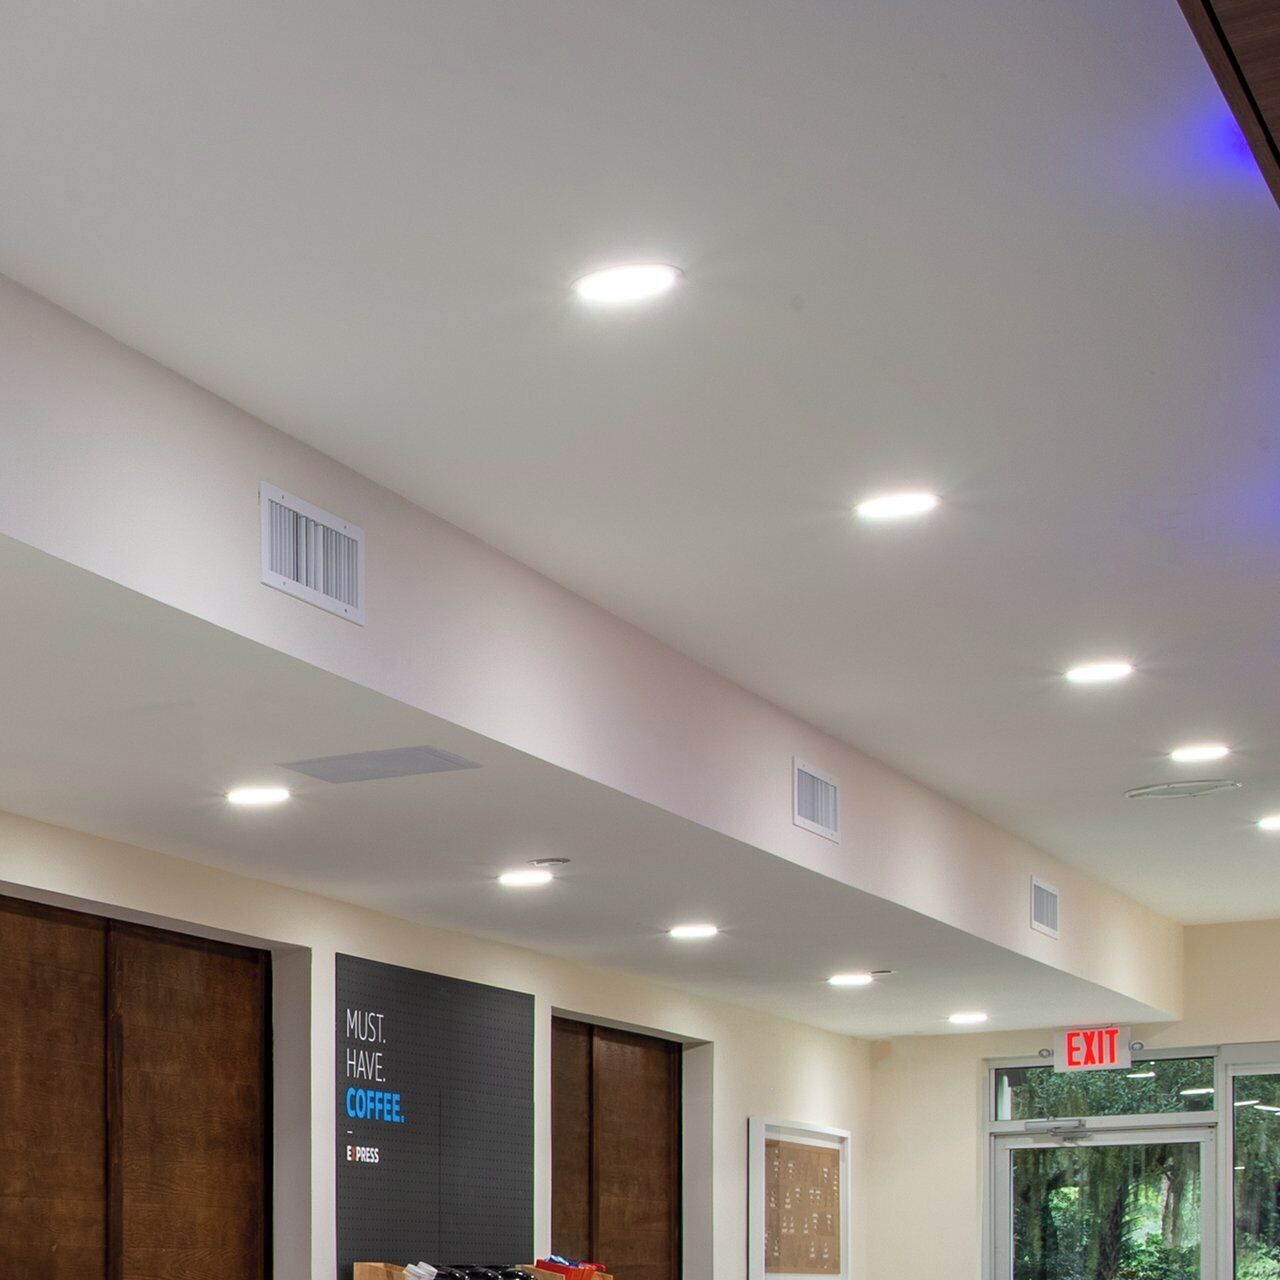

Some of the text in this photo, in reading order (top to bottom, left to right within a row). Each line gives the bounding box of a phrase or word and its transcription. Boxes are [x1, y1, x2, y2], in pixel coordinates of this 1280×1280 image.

[346, 1008, 386, 1044] MUST.
[346, 1048, 386, 1082] HAVE.
[1066, 1028, 1119, 1067] EXIT
[346, 1087, 405, 1123] COFFEE.
